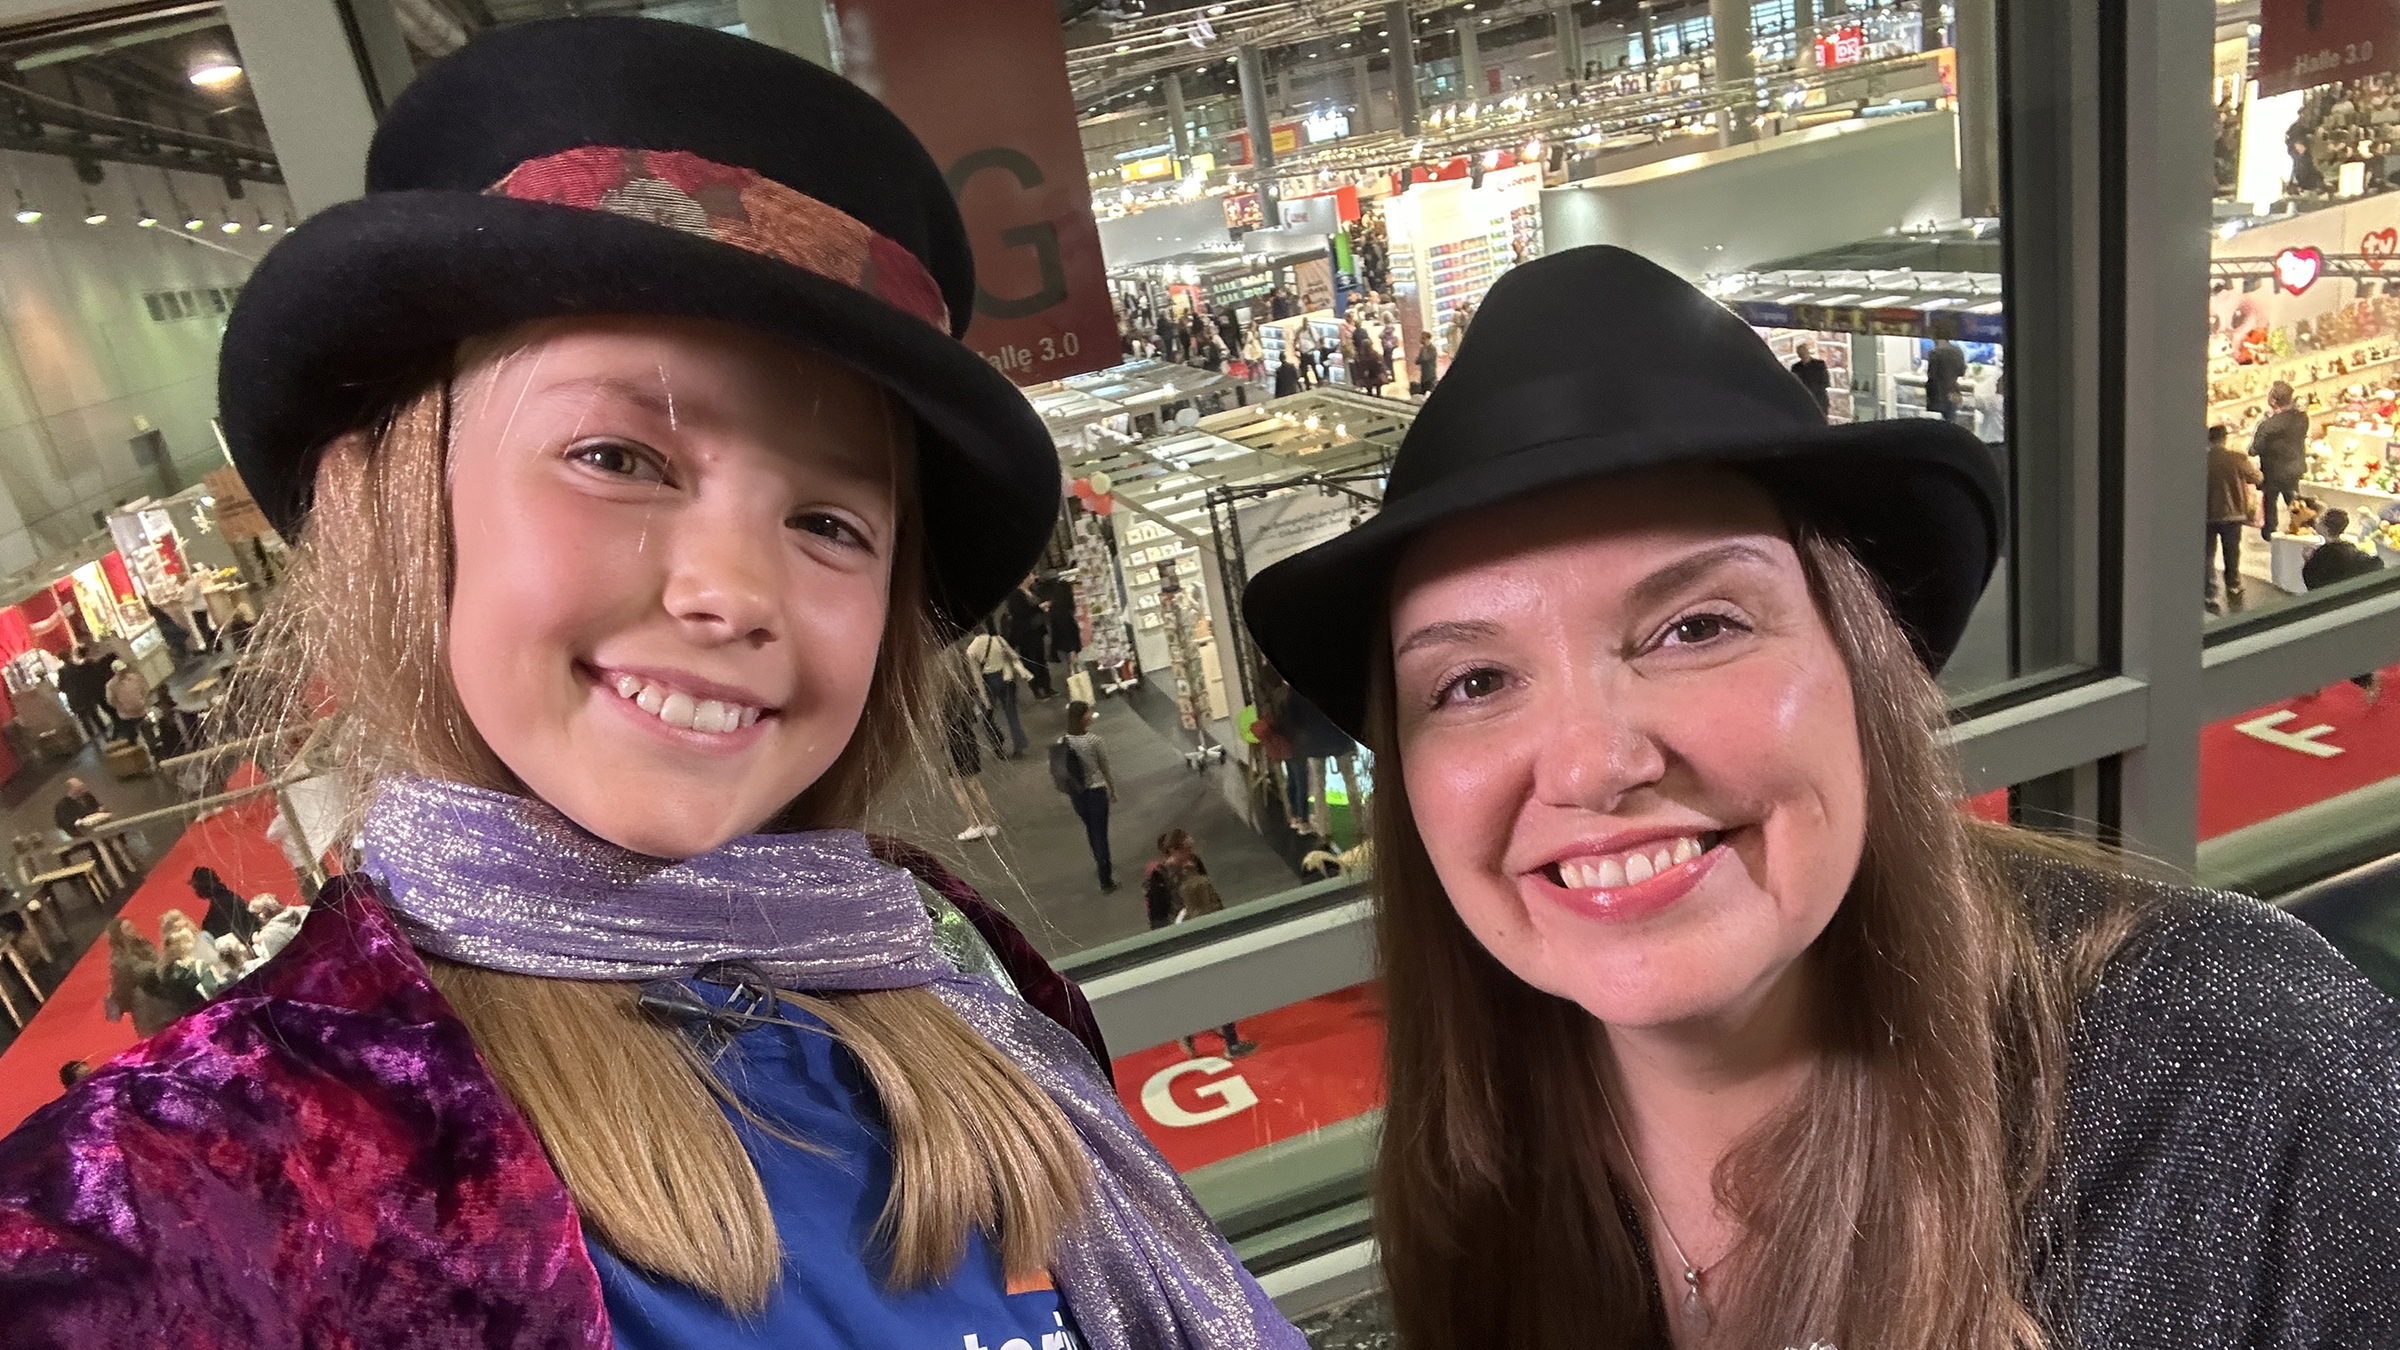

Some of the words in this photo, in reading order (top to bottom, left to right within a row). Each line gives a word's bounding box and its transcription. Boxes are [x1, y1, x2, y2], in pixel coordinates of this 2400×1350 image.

[1837, 39, 1858, 60] DK
[942, 147, 1068, 320] G
[978, 344, 1033, 371] alle
[1038, 332, 1079, 361] 3.0
[2234, 709, 2346, 758] F
[1141, 1056, 1259, 1128] G
